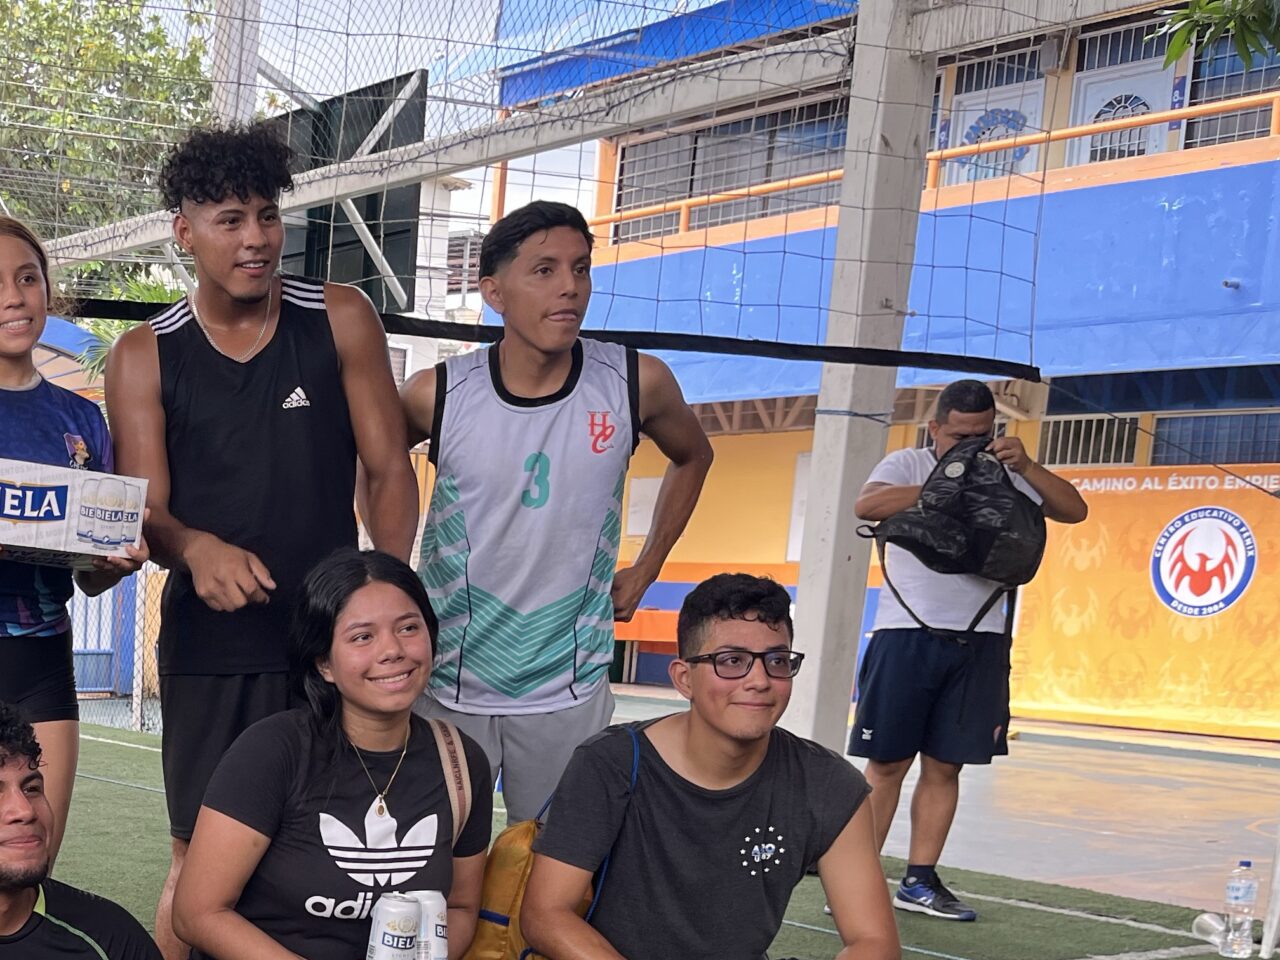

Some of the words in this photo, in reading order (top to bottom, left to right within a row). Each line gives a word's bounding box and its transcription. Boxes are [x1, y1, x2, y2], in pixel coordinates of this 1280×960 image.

[521, 451, 551, 509] 3
[1070, 477, 1137, 493] CAMINO
[1140, 477, 1163, 491] AL
[1167, 473, 1219, 490] ÉXITO
[81, 506, 95, 518] BIE
[96, 507, 123, 522] BIELA
[123, 513, 139, 523] ELA
[1154, 520, 1183, 558] CENTRO
[1183, 509, 1241, 527] EDUCATIVO
[1170, 600, 1200, 616] DESDE
[304, 891, 374, 920] adi
